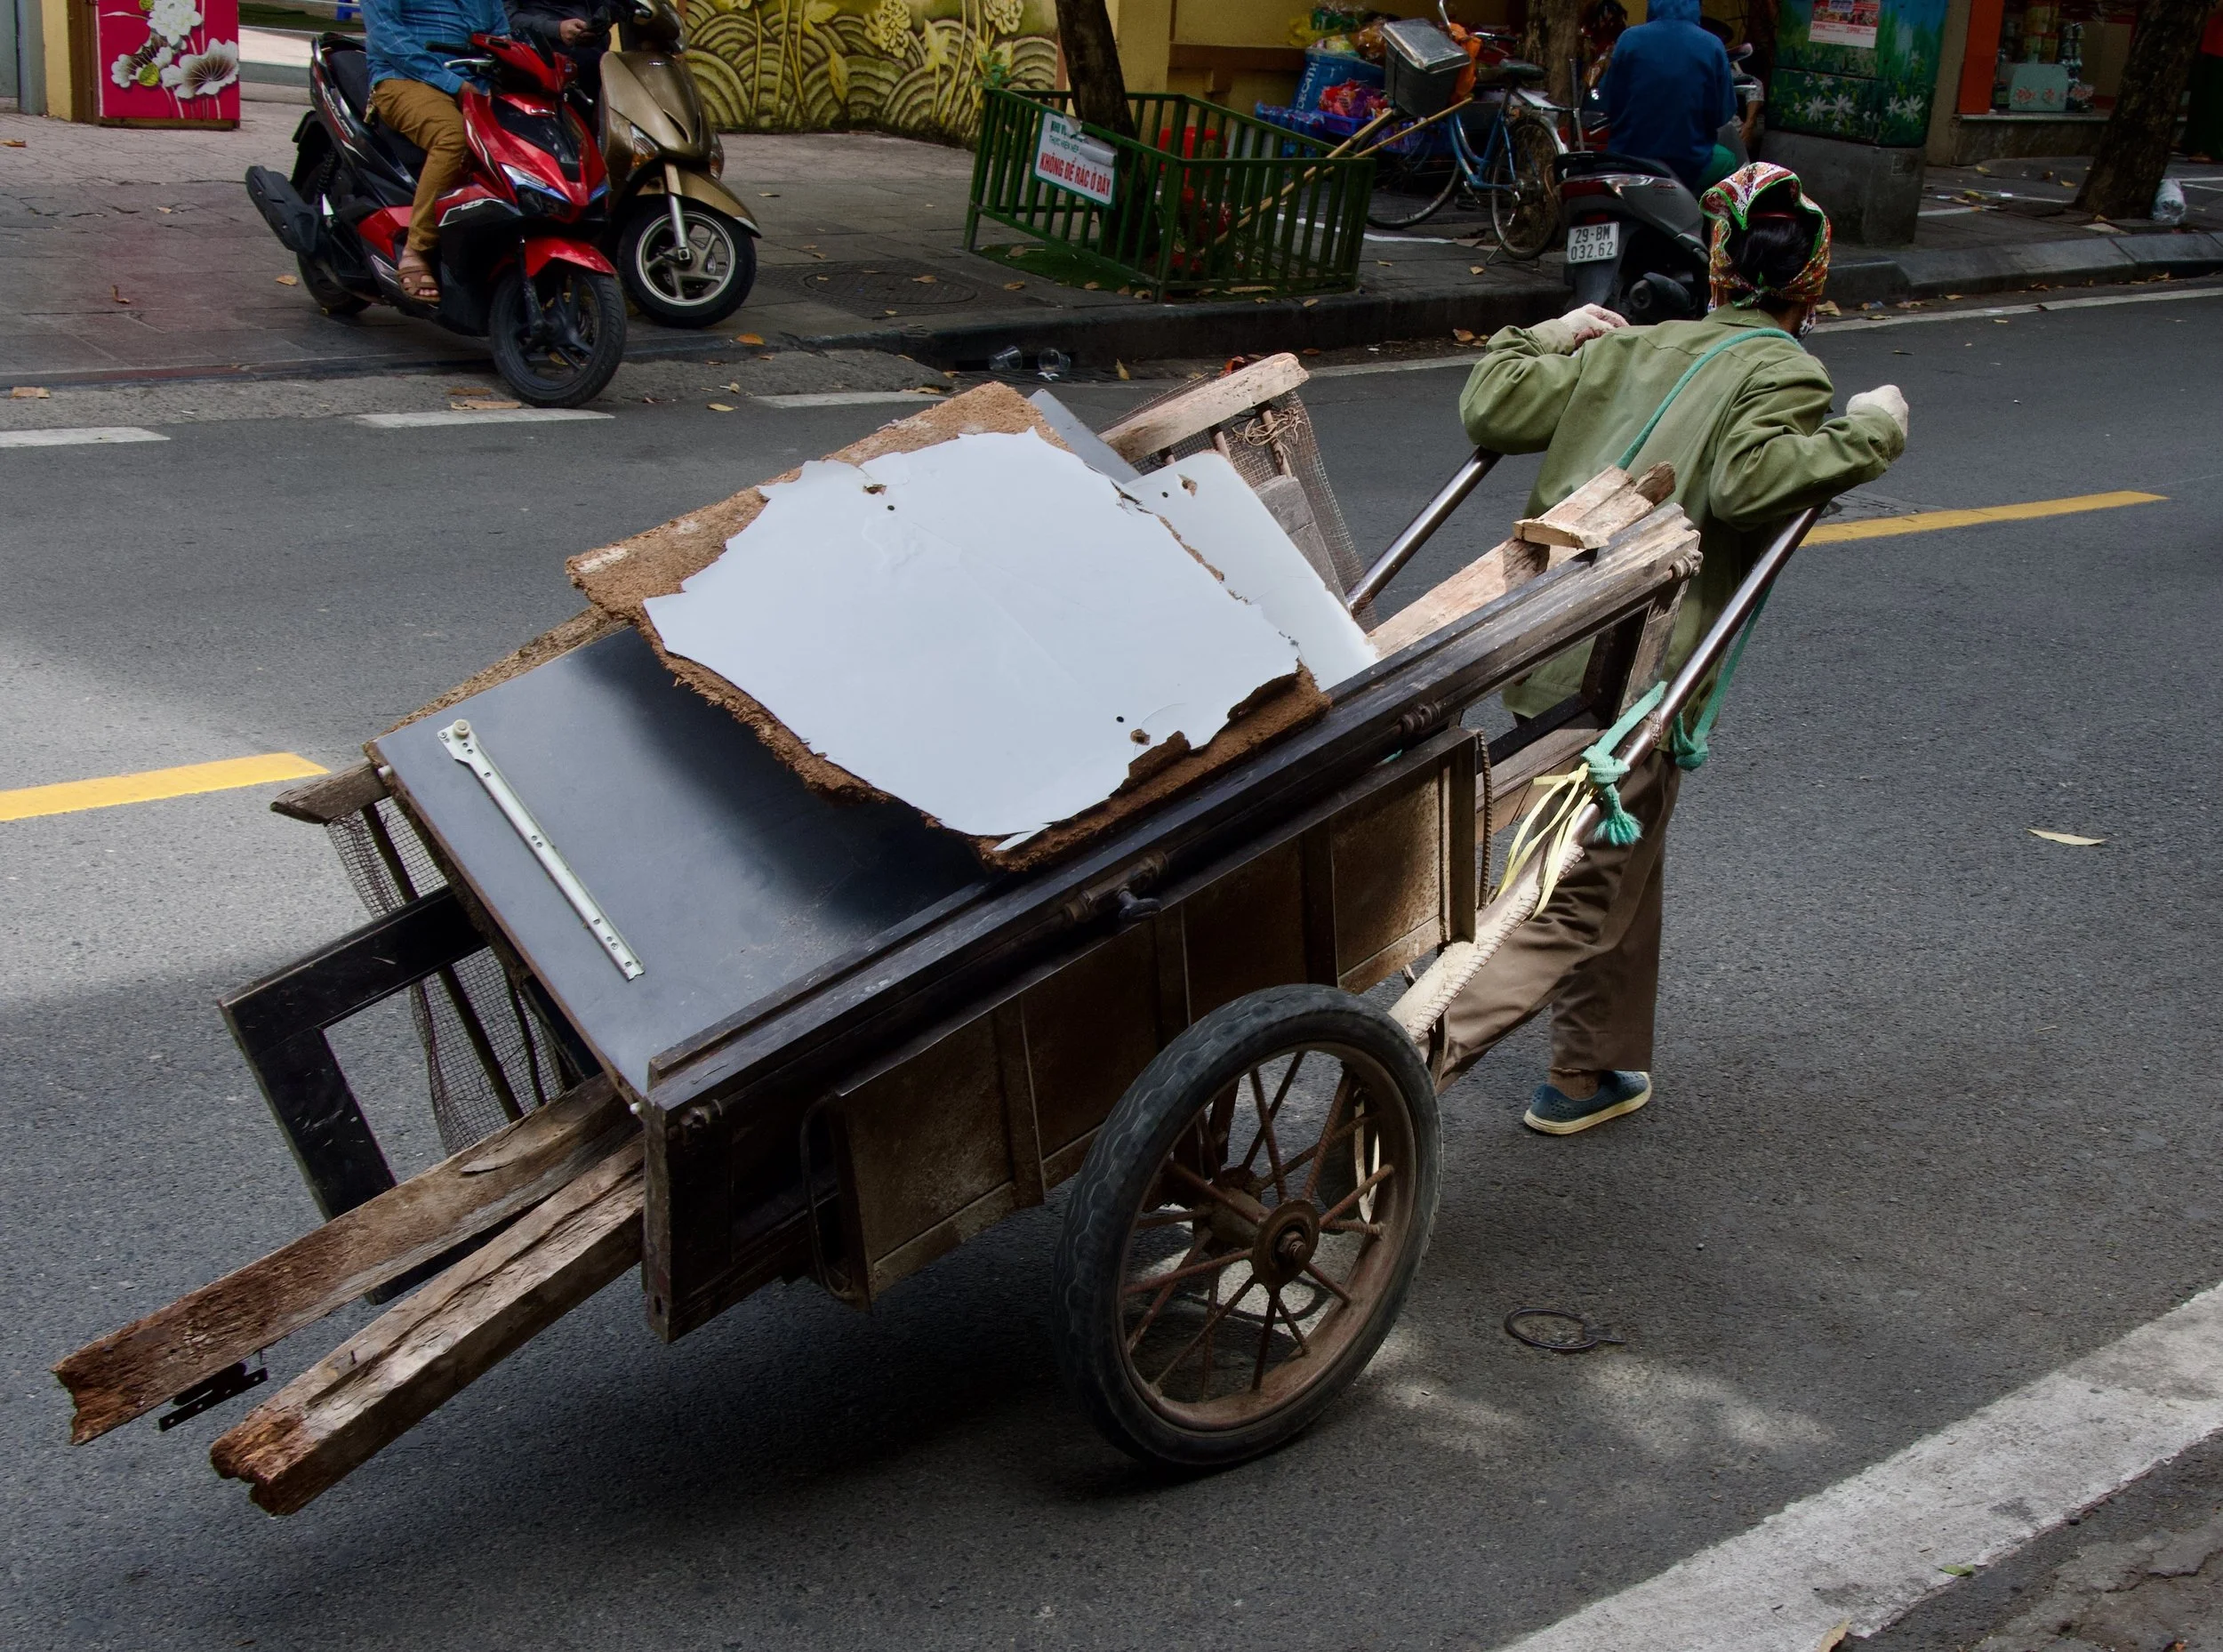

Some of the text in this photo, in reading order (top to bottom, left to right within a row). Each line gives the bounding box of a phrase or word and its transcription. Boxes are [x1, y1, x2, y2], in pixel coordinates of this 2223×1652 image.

[1039, 152, 1064, 177] KHÔNG
[1064, 156, 1076, 181] ĐỂ
[1075, 164, 1090, 188] RÁC
[1096, 172, 1111, 196] ĐÂY
[1575, 224, 1610, 244] 29-BM
[1570, 241, 1614, 261] 032.62
